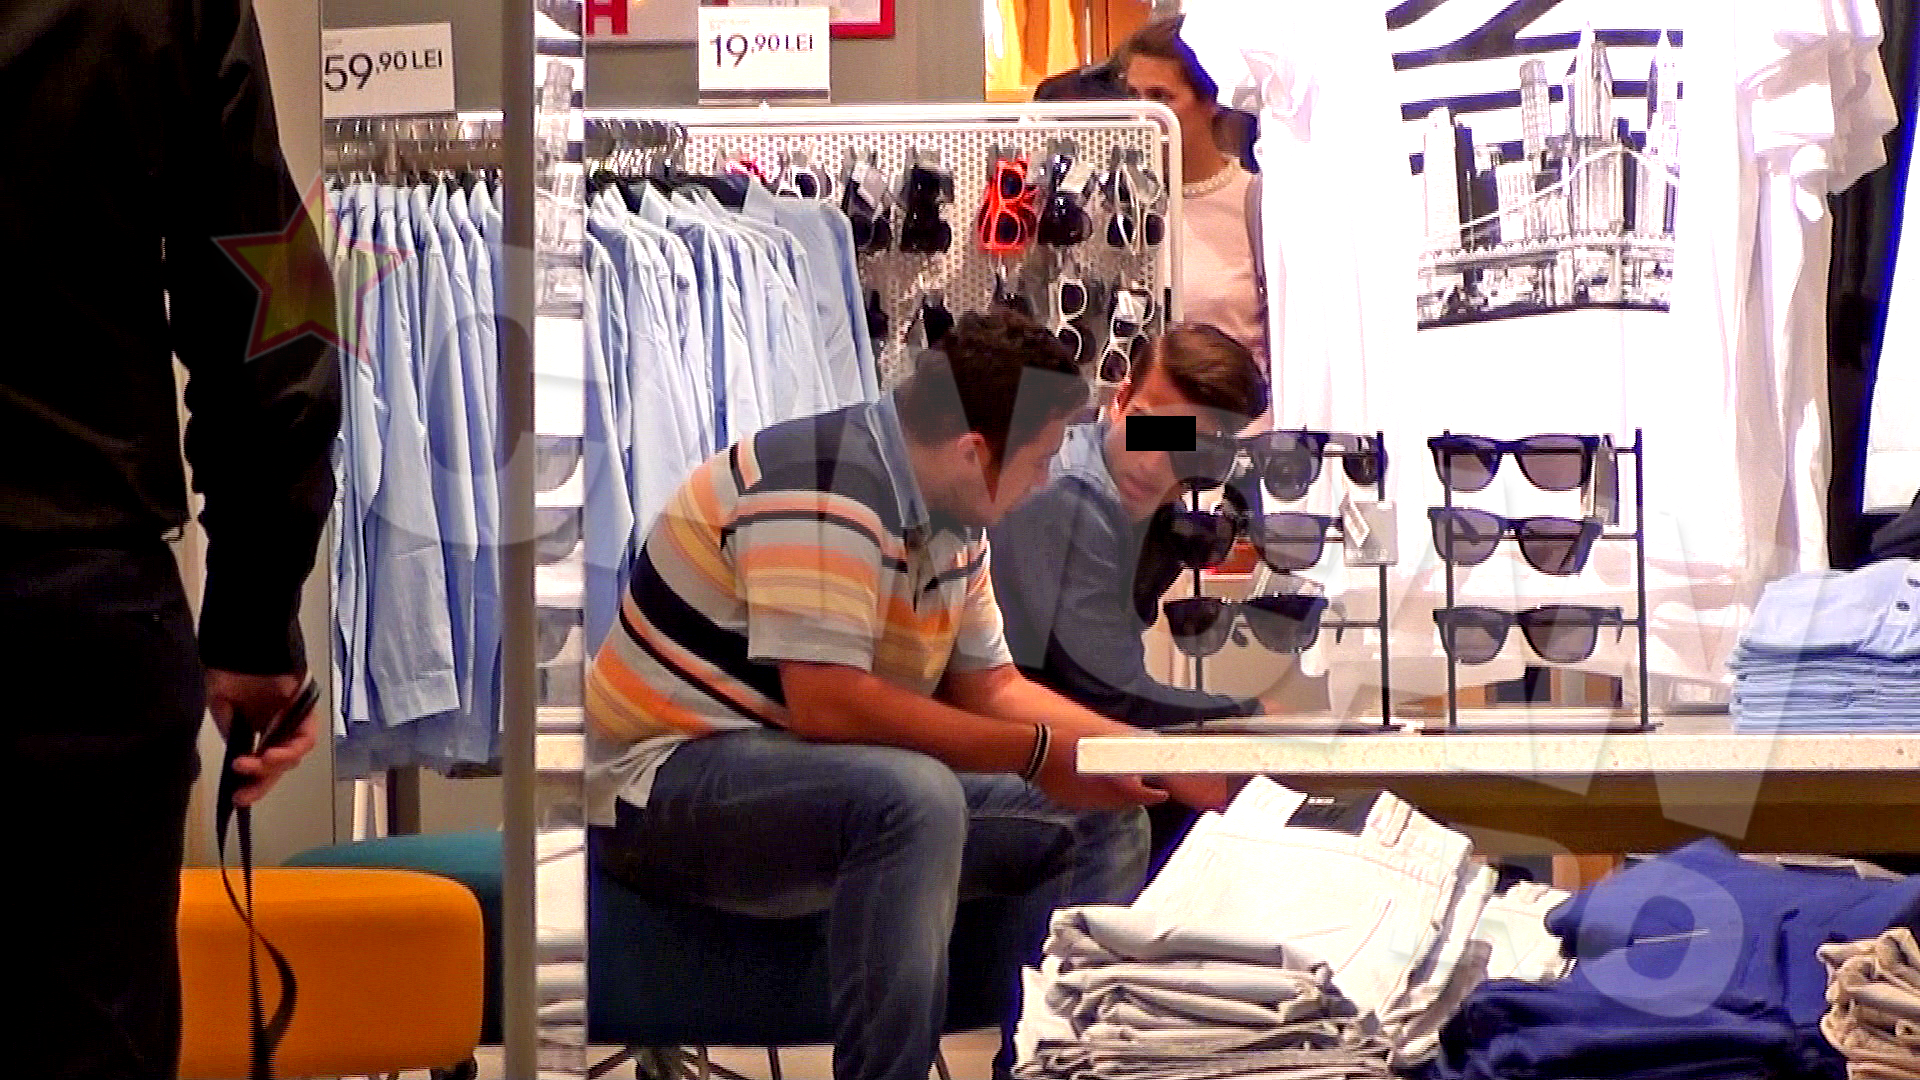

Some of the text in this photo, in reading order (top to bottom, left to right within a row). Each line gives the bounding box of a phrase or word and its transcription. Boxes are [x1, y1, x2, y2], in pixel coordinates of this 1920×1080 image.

[785, 33, 813, 52] LEI
[324, 48, 442, 92] 59,90 LEI
